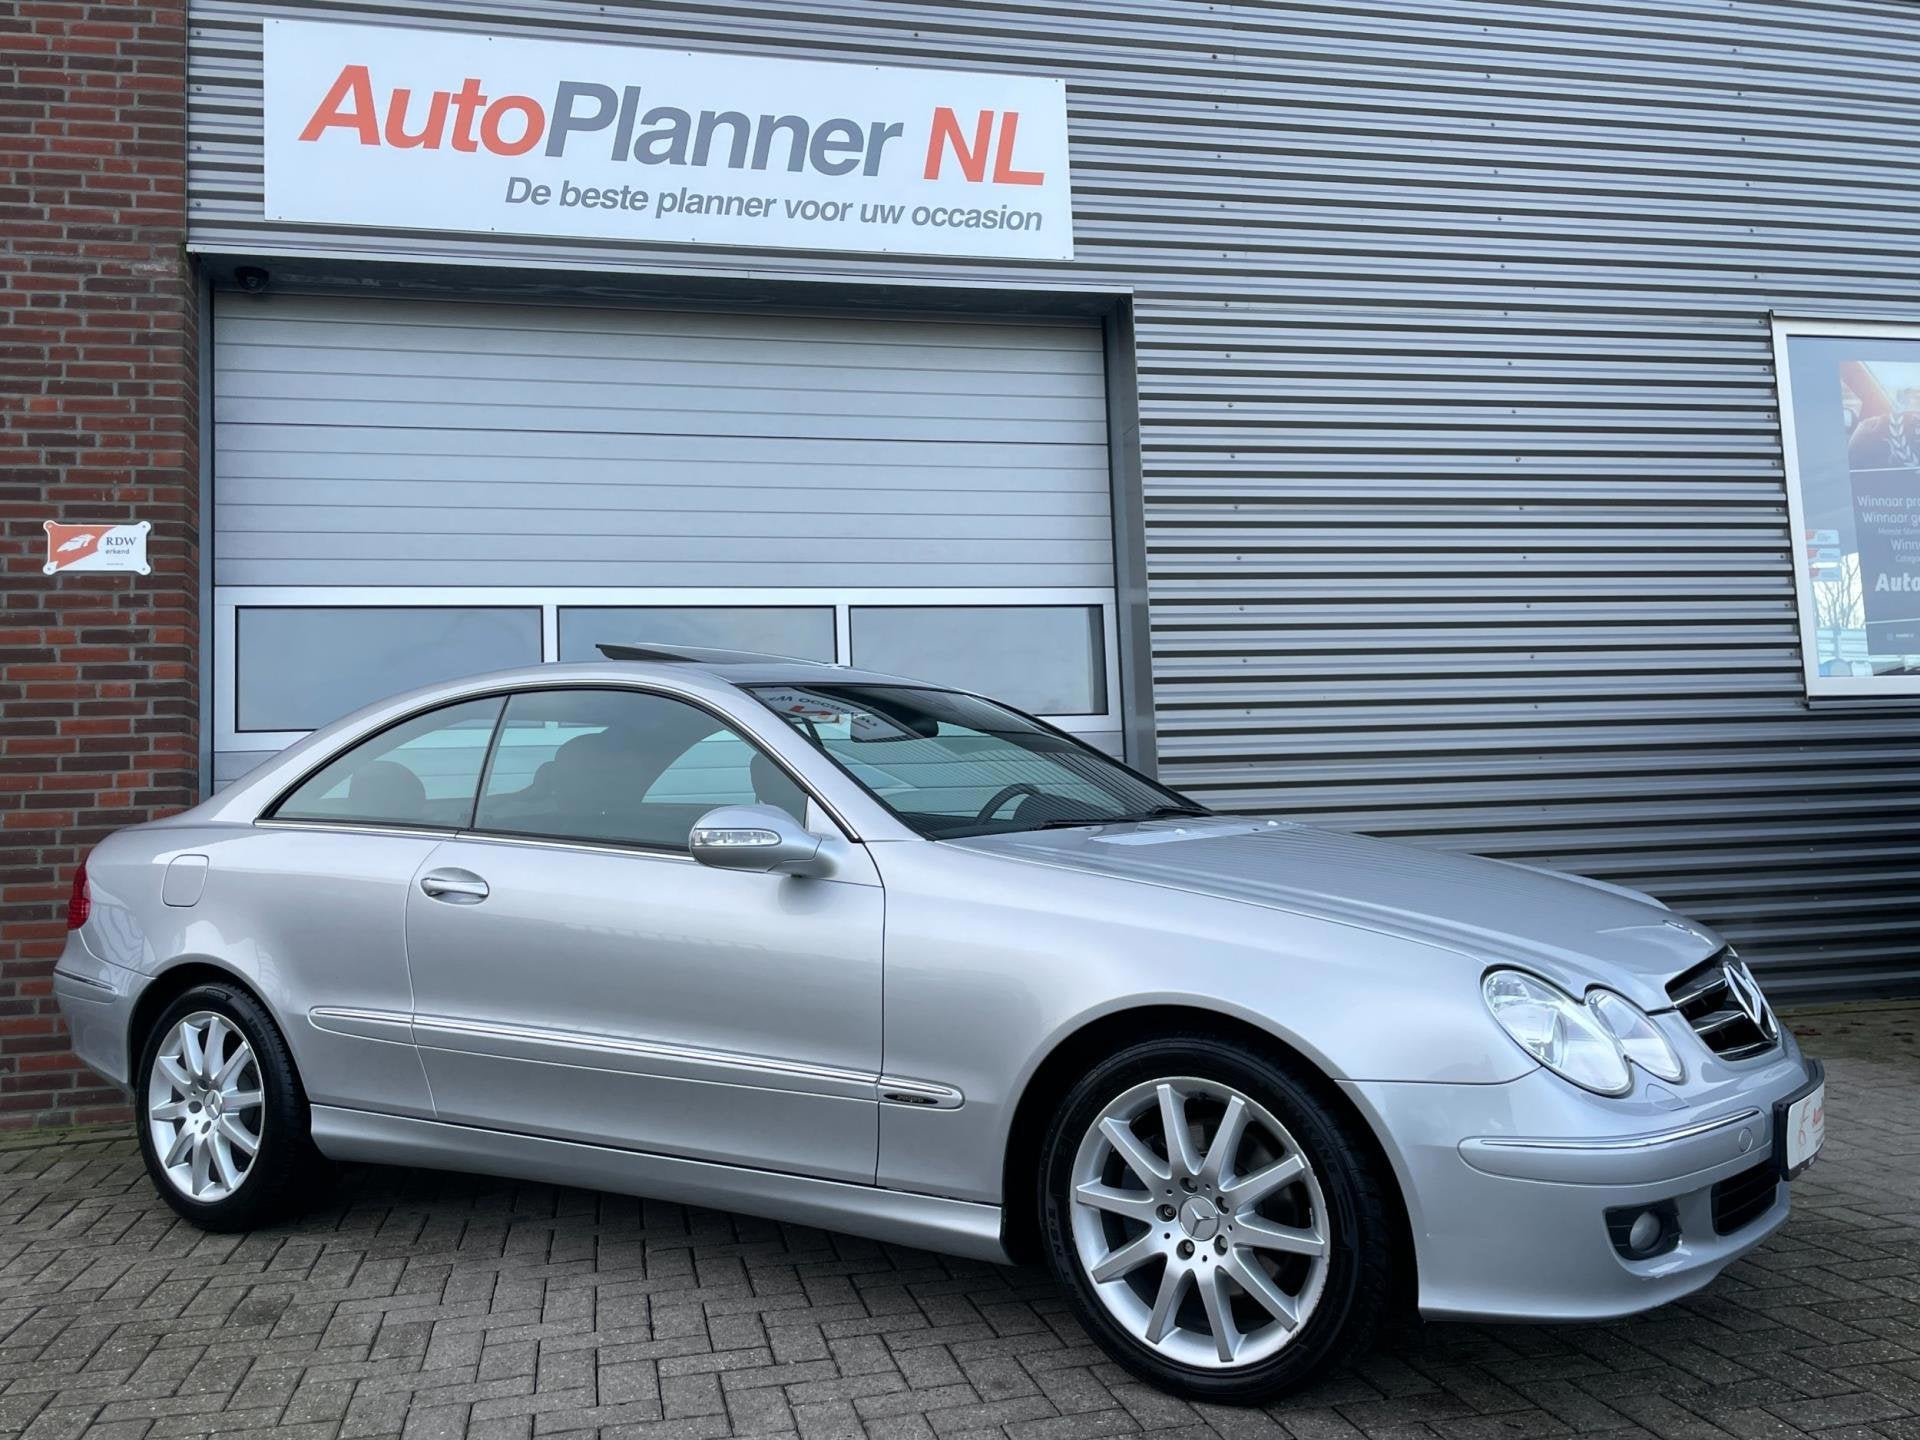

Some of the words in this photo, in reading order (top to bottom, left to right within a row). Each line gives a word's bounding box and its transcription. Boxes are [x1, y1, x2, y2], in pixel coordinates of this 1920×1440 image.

[298, 65, 904, 177] AutoPlanner
[923, 107, 1045, 186] NL
[505, 177, 552, 204] De
[559, 180, 649, 211] beste
[655, 191, 777, 219] planner
[784, 200, 854, 222] voor
[859, 203, 906, 224] uw
[911, 204, 1043, 231] occasion
[1857, 496, 1903, 507] Winnaar
[1863, 512, 1908, 523] Winnaar
[106, 537, 137, 546] RDW
[1875, 572, 1920, 592] Auto
